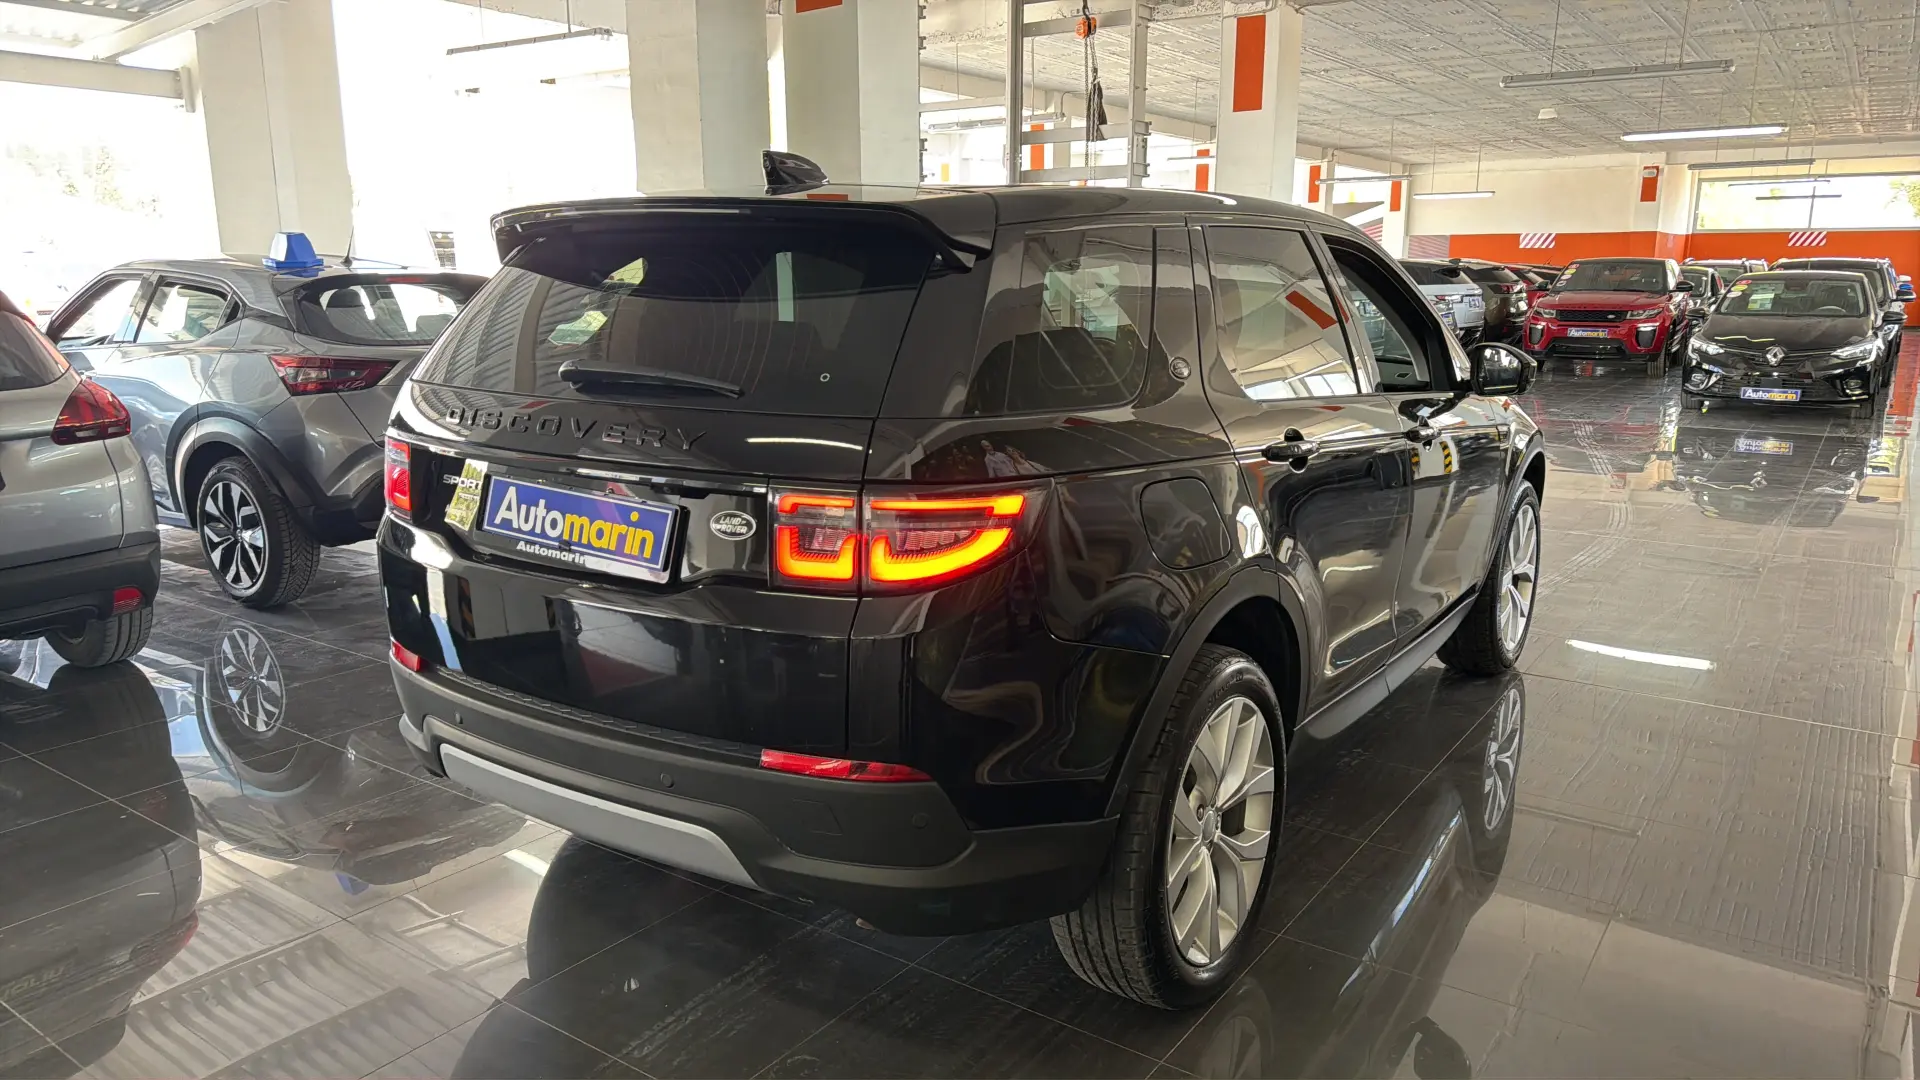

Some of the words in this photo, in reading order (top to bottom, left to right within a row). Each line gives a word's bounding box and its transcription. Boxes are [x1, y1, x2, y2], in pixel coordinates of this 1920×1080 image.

[1745, 388, 1797, 400] Automarin
[445, 405, 706, 449] DISCOVERY
[443, 474, 483, 490] SPORT
[494, 485, 655, 559] Automarin
